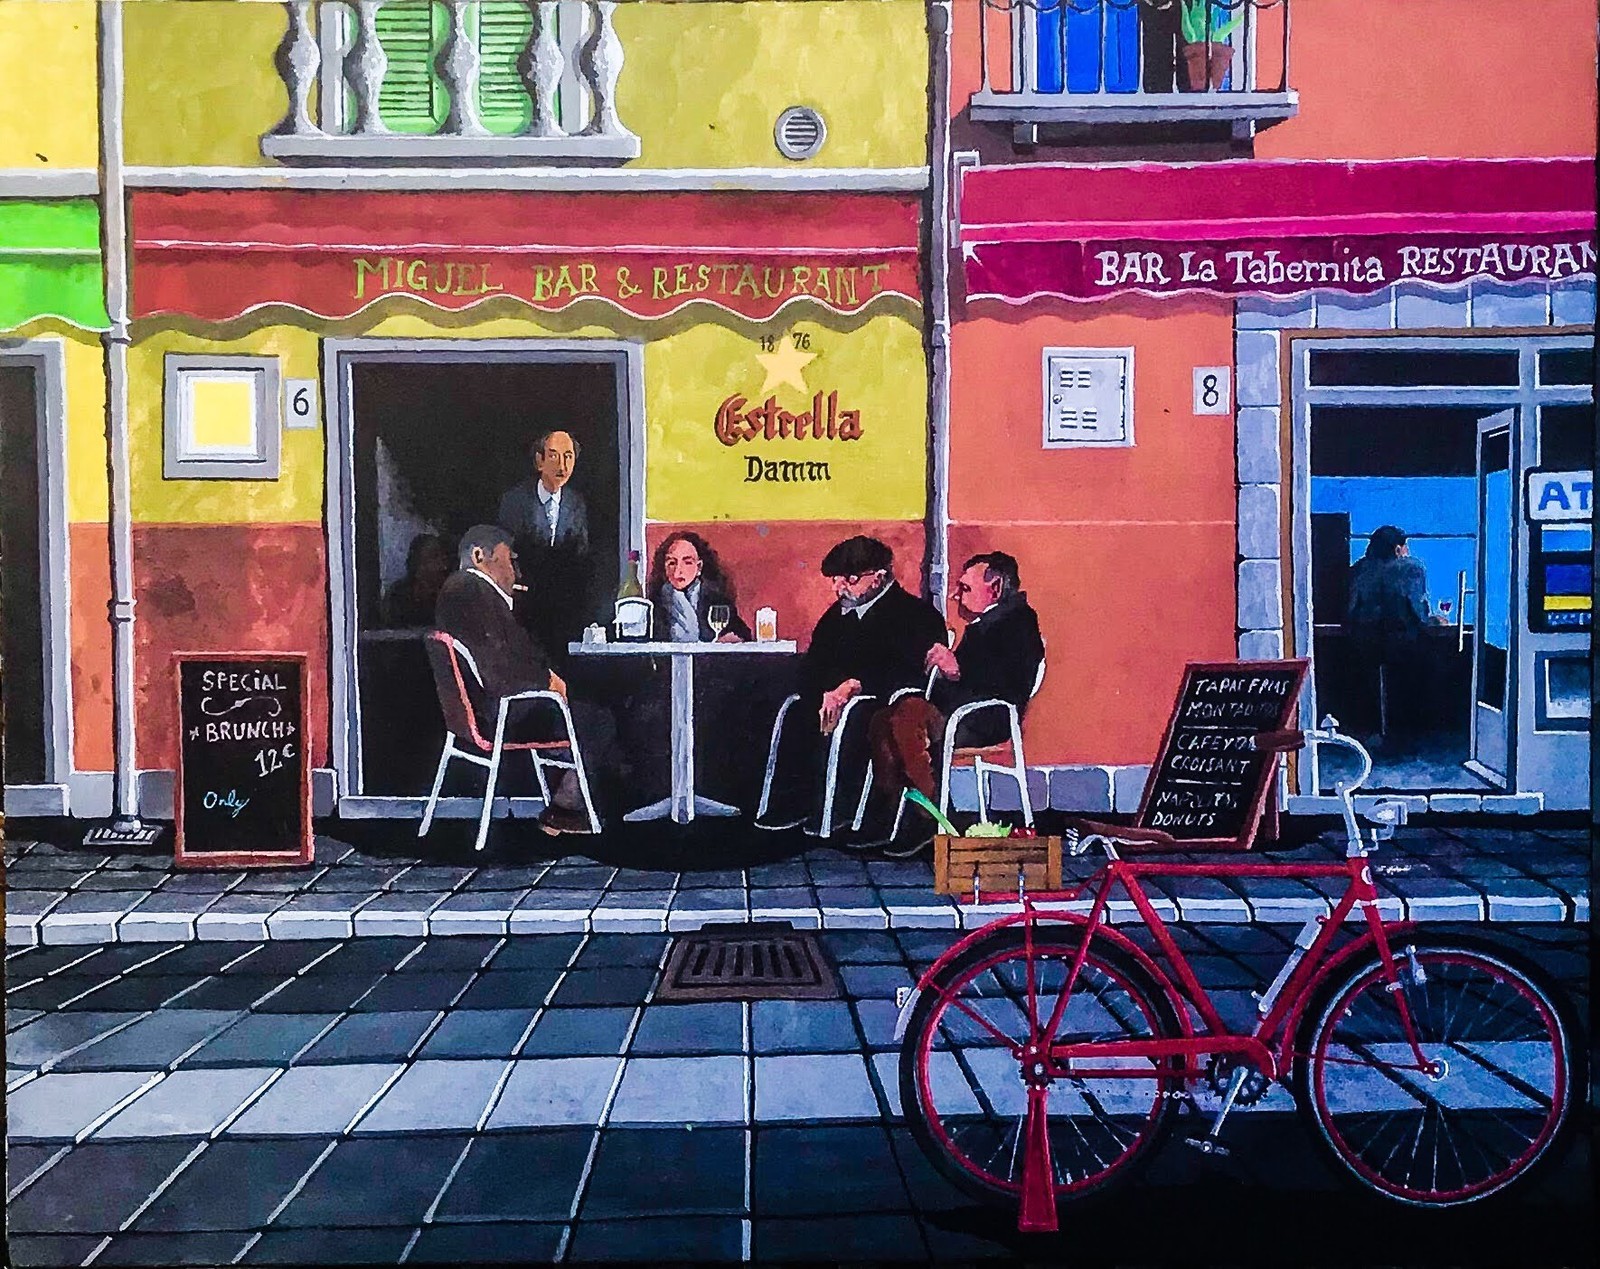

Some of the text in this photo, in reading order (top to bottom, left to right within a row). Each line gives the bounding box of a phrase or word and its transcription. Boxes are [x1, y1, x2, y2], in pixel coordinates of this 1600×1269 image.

[353, 257, 890, 305] MIGUEL BAR & RESTAURANT
[1094, 250, 1172, 286] BAR
[1179, 251, 1219, 282] La
[1225, 247, 1386, 285] Tabernita
[759, 332, 812, 353] 18 76
[293, 387, 310, 416] 6
[1202, 374, 1219, 407] 8
[714, 389, 864, 447] Estrella
[743, 455, 832, 482] Damm
[205, 720, 285, 742] BRUNCH
[203, 789, 251, 819] Only
[1151, 810, 1217, 827] DONUTS
